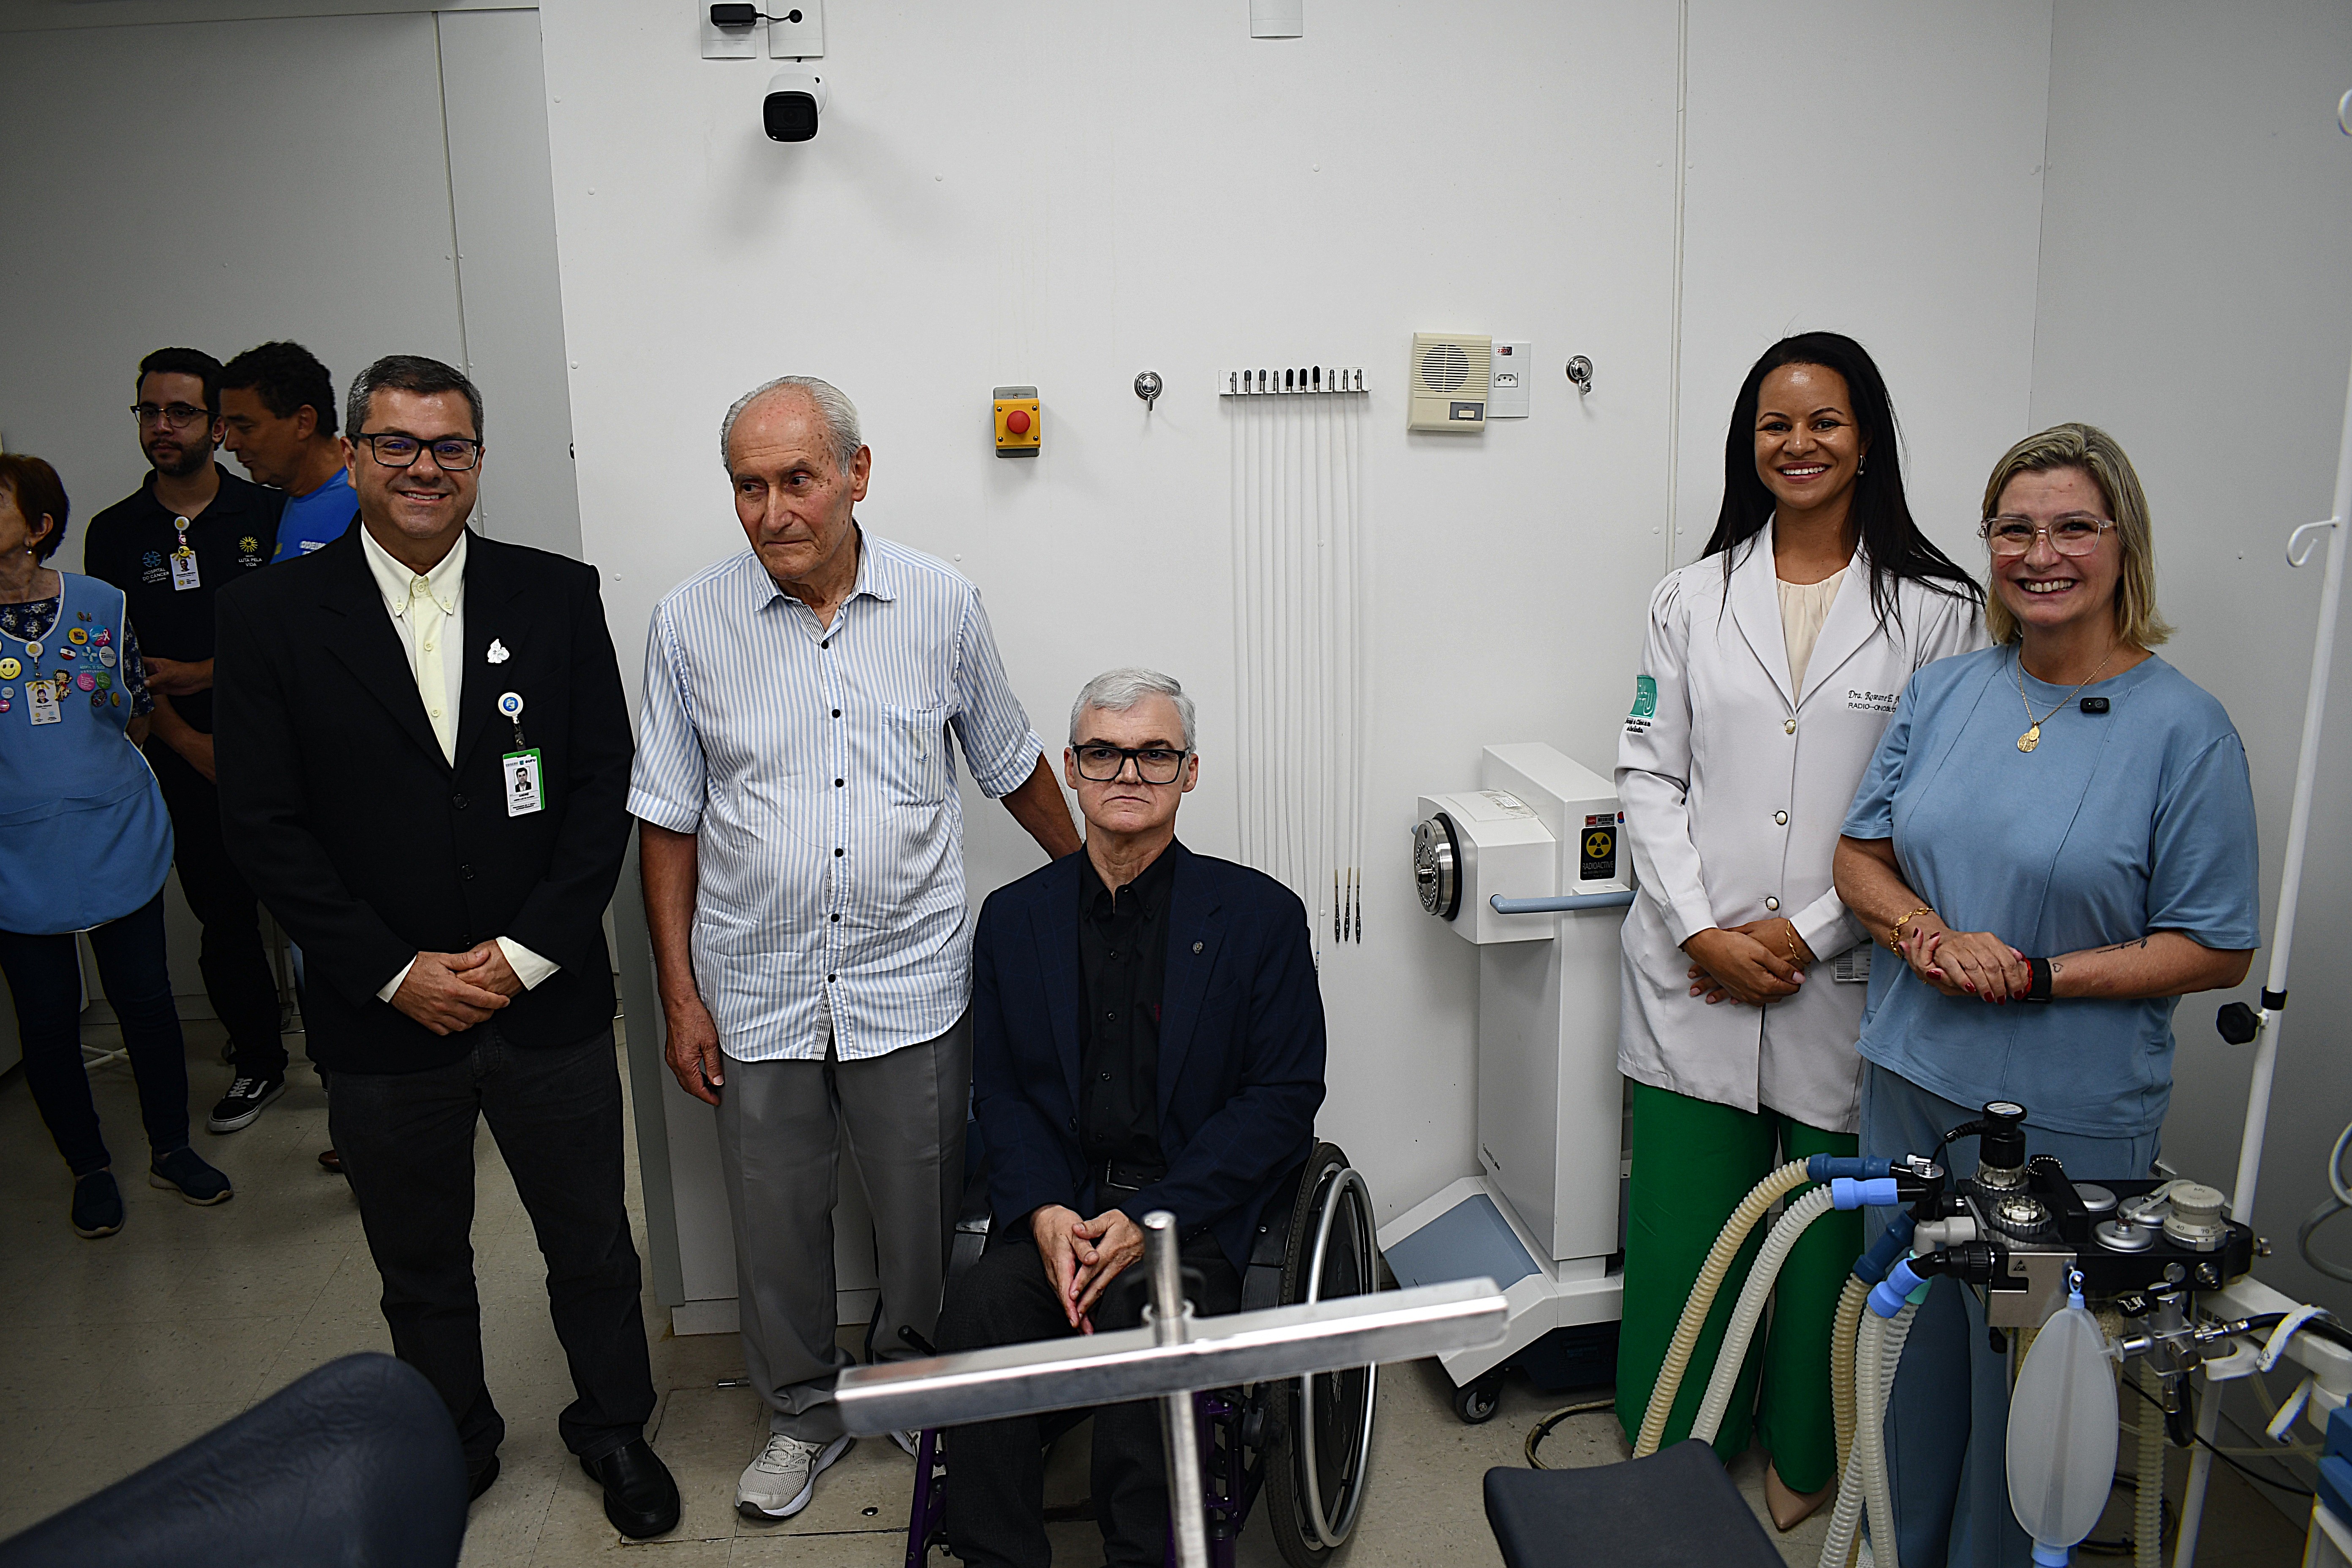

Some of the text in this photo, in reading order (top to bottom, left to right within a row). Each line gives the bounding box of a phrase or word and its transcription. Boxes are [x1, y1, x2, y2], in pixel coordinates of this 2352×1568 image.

[1848, 690, 1862, 699] Dra.
[1865, 691, 1887, 701] Roseane
[1582, 861, 1614, 869] RADIOACTIVE
